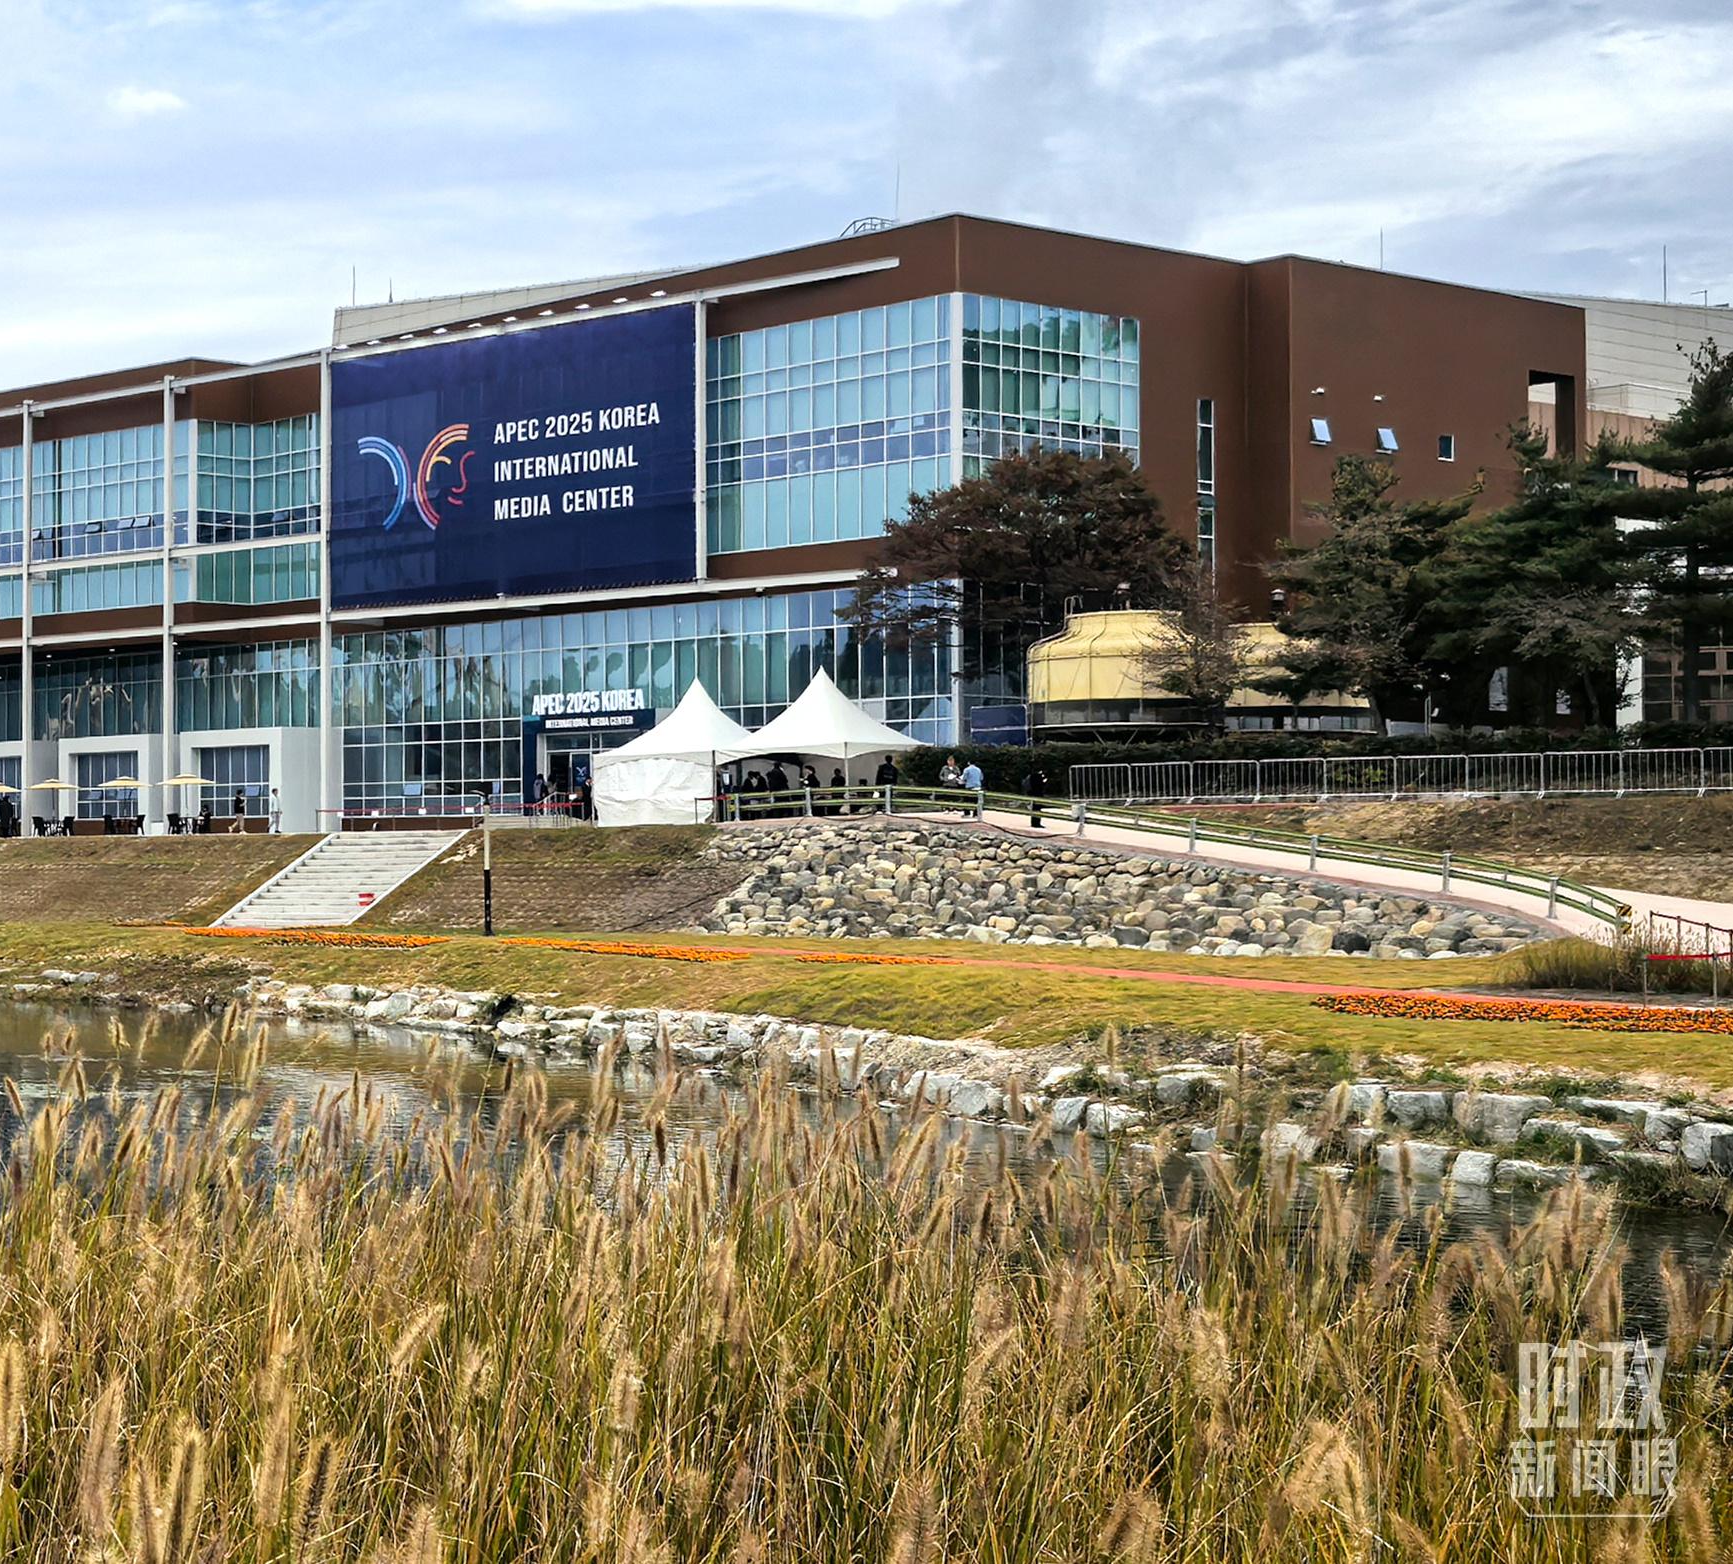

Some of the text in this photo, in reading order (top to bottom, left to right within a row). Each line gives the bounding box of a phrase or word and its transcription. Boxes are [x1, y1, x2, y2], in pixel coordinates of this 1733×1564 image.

[493, 402, 660, 444] APEC 2025 KOREA
[494, 445, 639, 483] INTERNATIONAL
[494, 485, 634, 521] MEDIA CENTER
[532, 688, 645, 716] APEC 2025 KOREA
[545, 716, 634, 729] INTERNATIONAL MEDIA CENTER
